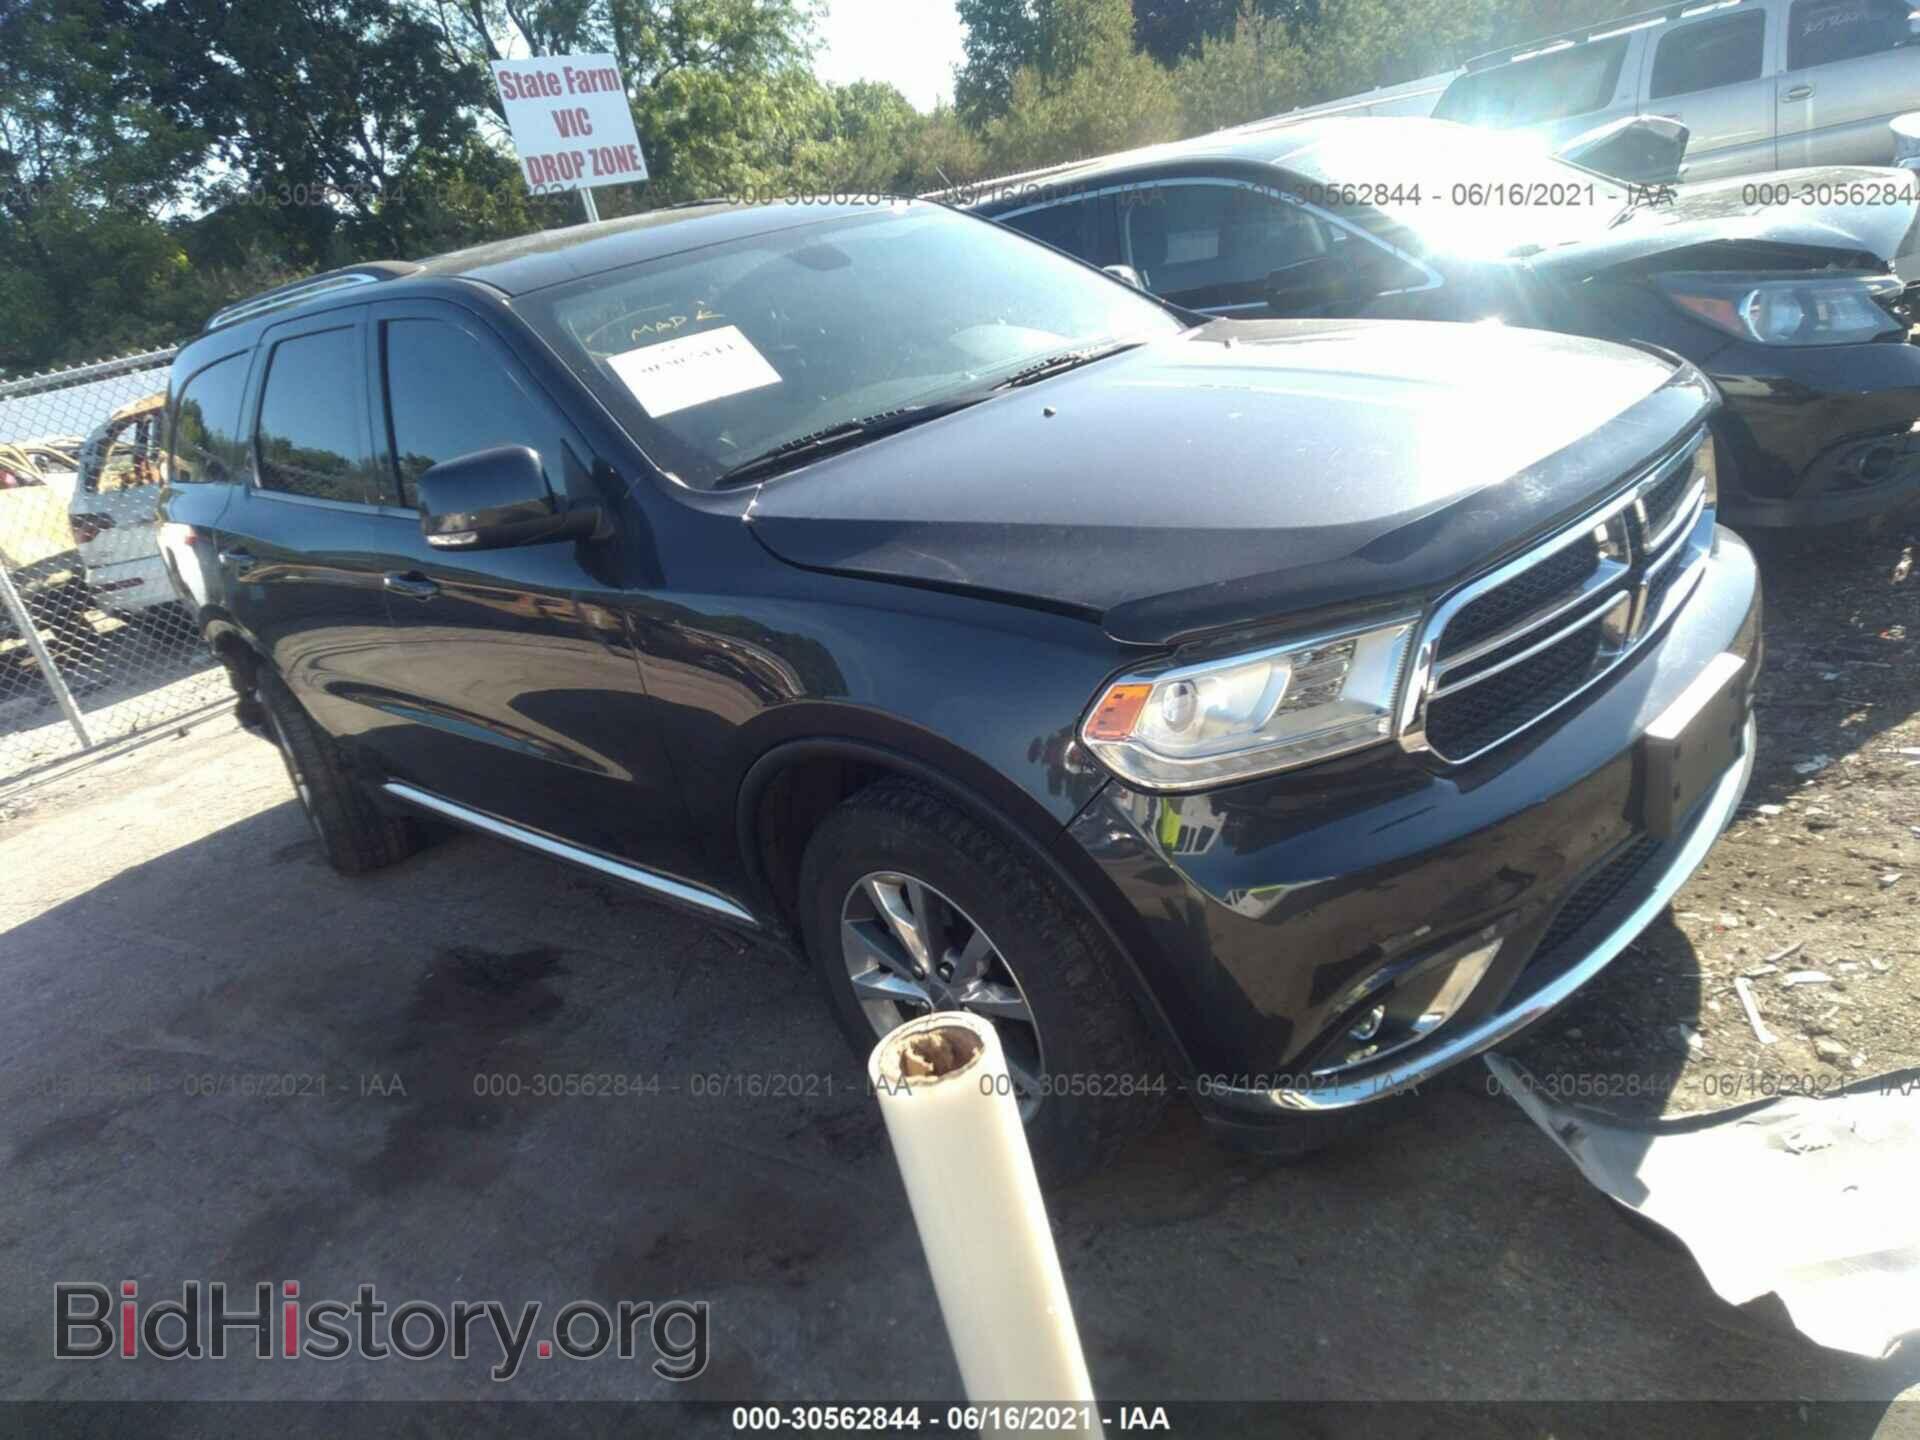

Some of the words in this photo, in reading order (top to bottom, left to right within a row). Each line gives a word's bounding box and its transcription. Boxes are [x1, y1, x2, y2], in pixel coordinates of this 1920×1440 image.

[498, 69, 563, 100] State
[563, 66, 621, 94] Farm
[551, 107, 593, 138] VIC
[526, 151, 585, 185] DROP
[588, 143, 642, 177] ZONE
